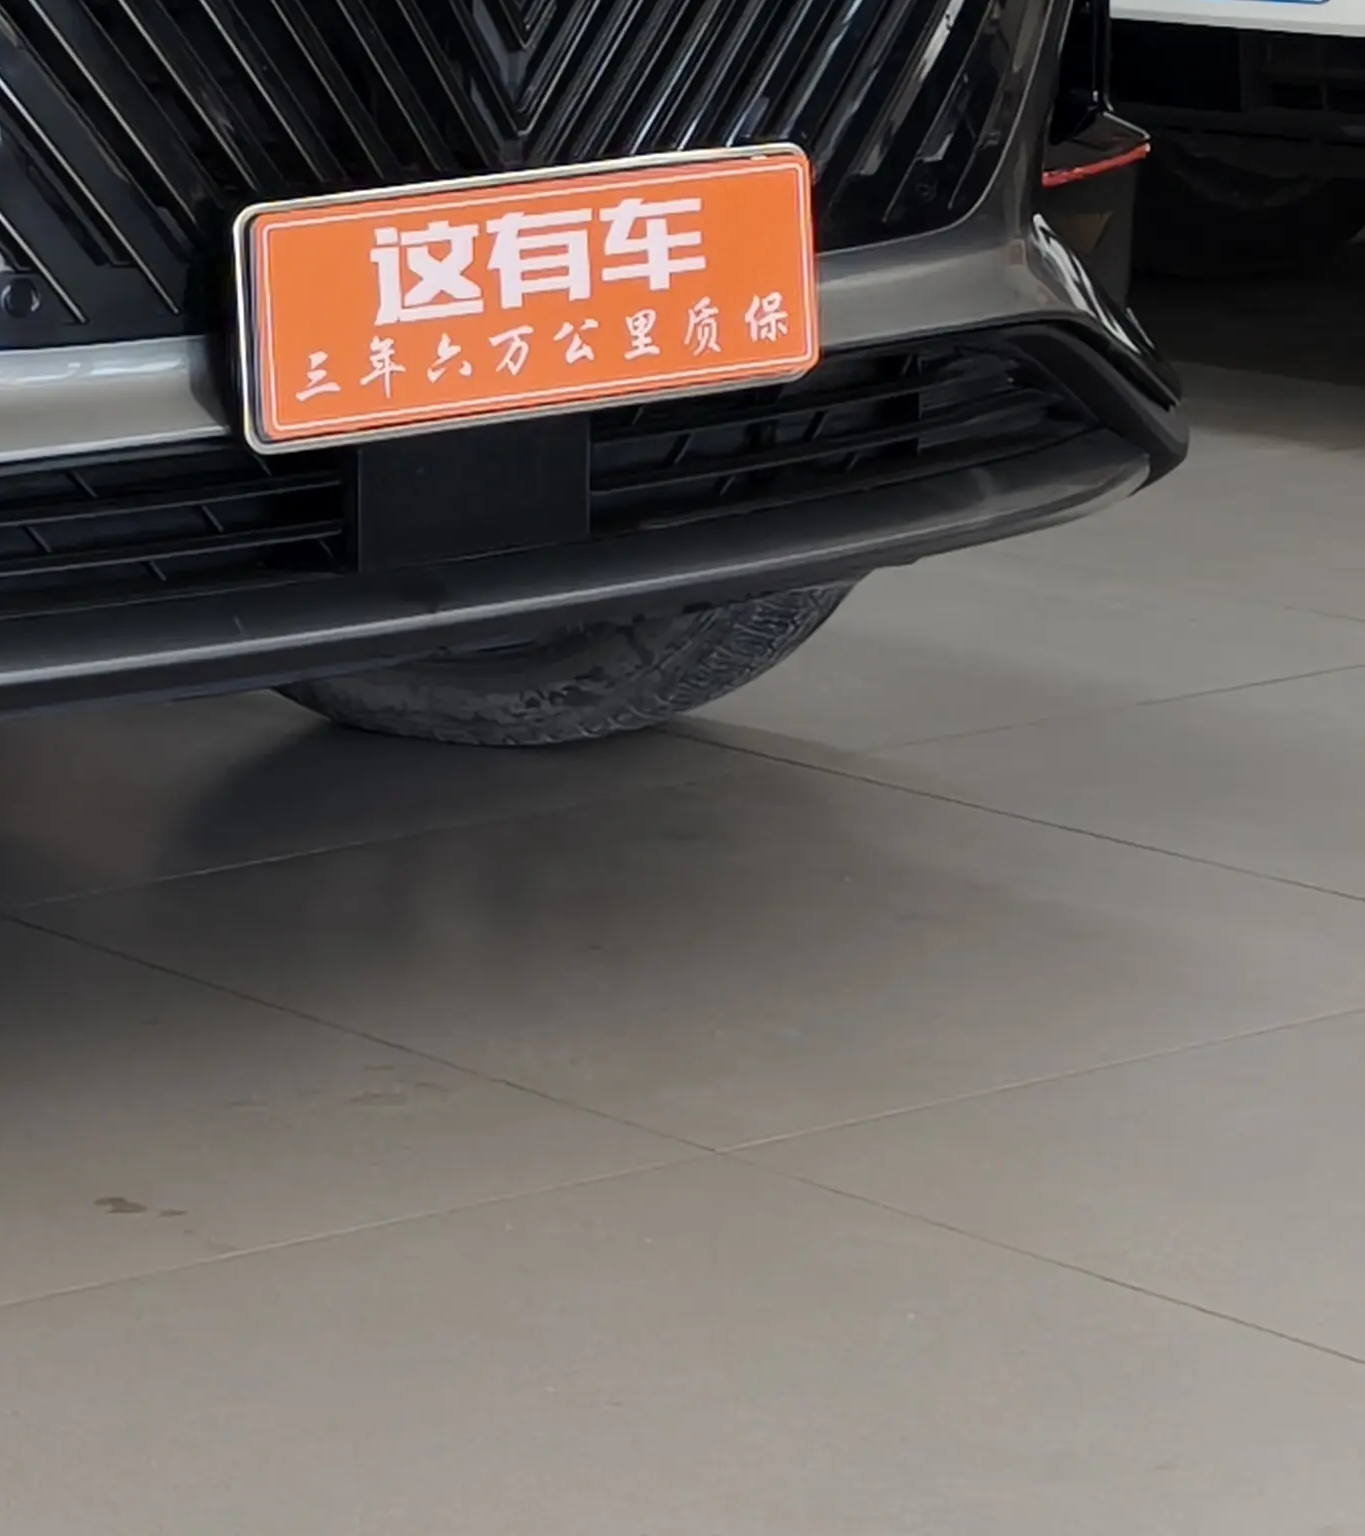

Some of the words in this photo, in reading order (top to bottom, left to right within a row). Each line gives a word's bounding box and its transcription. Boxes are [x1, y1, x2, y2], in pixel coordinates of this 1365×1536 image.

[369, 197, 706, 325] 这有车
[295, 291, 790, 403] 三年六万公里质保
